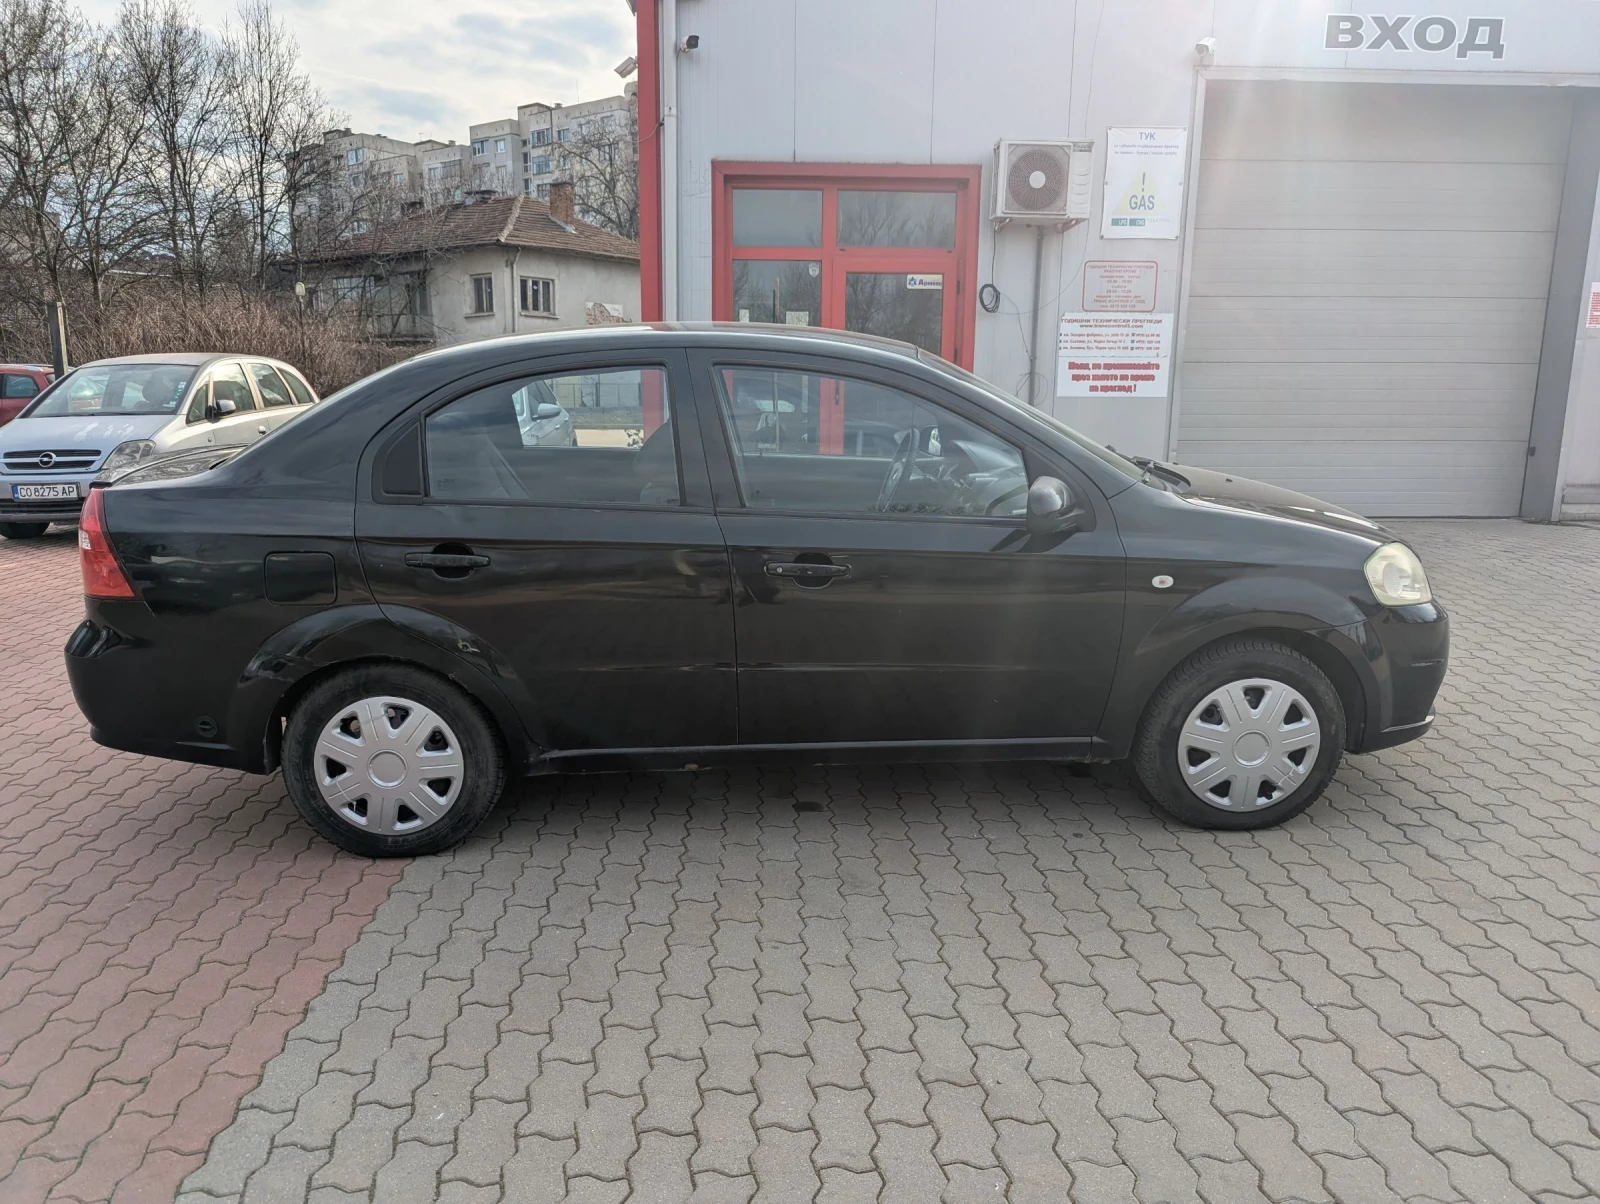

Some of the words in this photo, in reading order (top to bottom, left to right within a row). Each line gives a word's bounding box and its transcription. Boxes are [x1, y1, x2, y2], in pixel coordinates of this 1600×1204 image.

[1324, 13, 1506, 60] ВХОД
[1139, 132, 1156, 140] ТУК
[1129, 195, 1155, 210] GAS
[34, 487, 59, 497] 8275
[62, 486, 75, 496] AP
